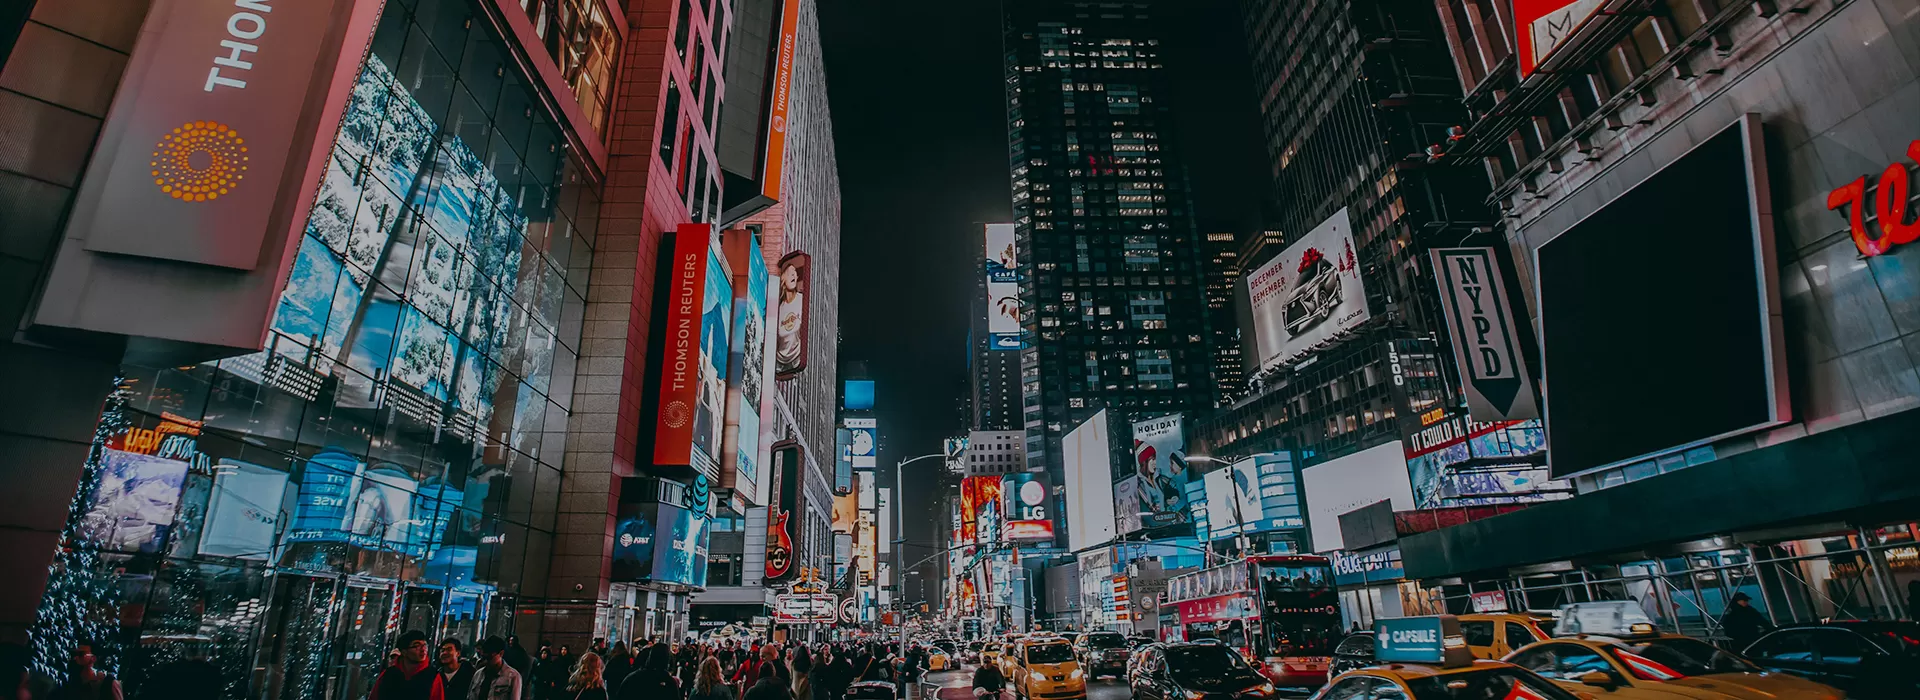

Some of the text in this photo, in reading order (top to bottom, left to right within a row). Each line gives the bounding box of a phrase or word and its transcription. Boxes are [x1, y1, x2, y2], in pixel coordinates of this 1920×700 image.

[777, 33, 793, 111] THOMSON REUTERS
[1250, 262, 1283, 290] DECEMBER
[1252, 276, 1286, 304] REMEMBER
[672, 252, 697, 391] THOMSON REUTERS
[1456, 257, 1502, 377] NYPD
[1388, 341, 1404, 386] 1500
[1137, 419, 1177, 434] HOLIDAY
[1410, 432, 1422, 452] IT
[1421, 421, 1453, 449] COULD
[1023, 505, 1045, 520] LG
[633, 536, 650, 545] AT&T
[1392, 629, 1437, 643] CAPSULE
